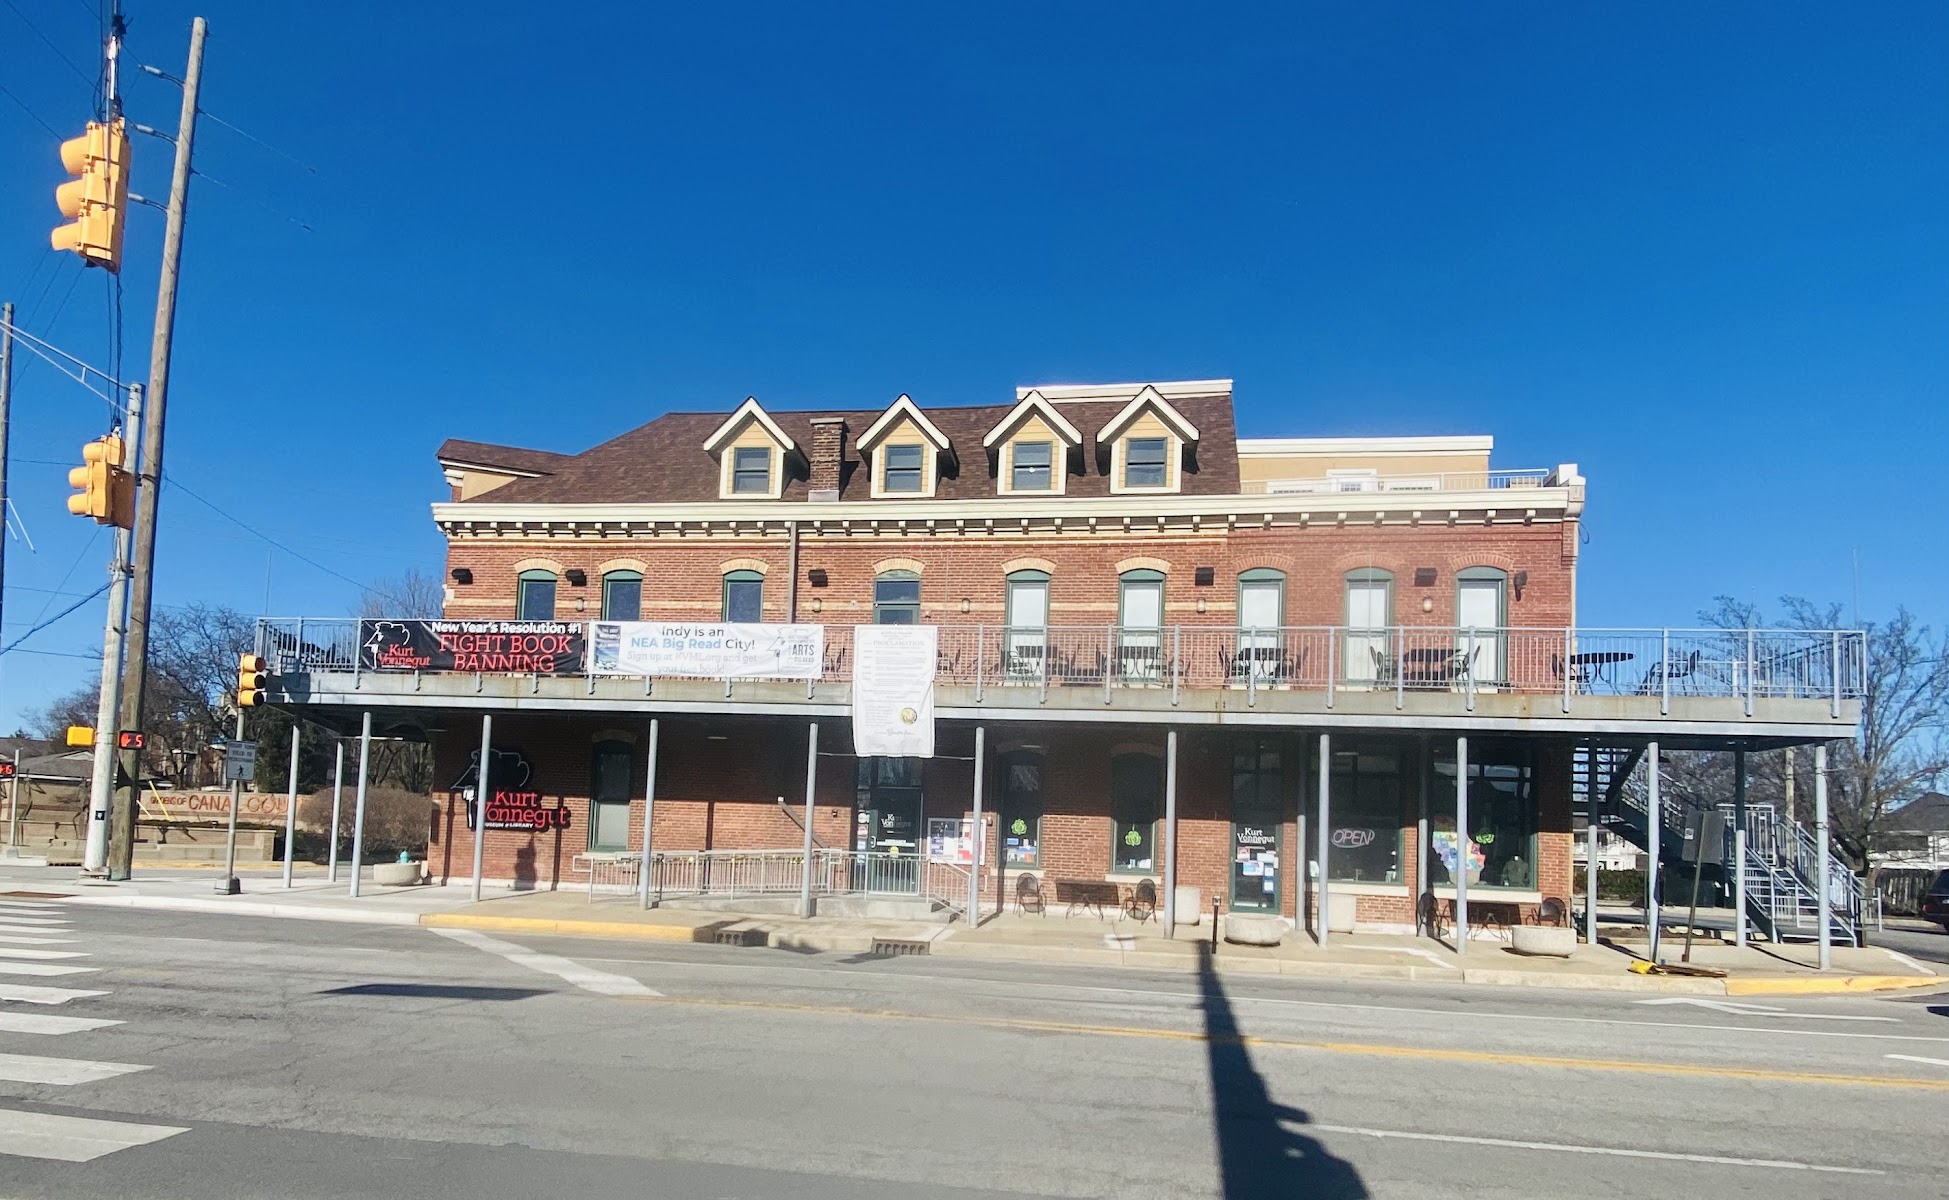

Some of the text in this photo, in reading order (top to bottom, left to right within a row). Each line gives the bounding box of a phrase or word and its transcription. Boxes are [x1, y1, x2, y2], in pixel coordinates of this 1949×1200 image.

[432, 622, 581, 634] New Year's Resolution #1
[694, 626, 704, 637] is
[708, 628, 724, 637] an
[388, 644, 414, 656] Kurt
[439, 634, 573, 653] FIGHT BOOK
[631, 637, 756, 651] NEA Big Read City!
[792, 644, 815, 656] ARTS
[378, 653, 431, 669] Vonnegut
[453, 654, 554, 672] BANNING
[627, 651, 648, 661] Sign
[650, 652, 662, 663] up
[664, 652, 673, 661] at
[723, 653, 741, 663] and
[743, 655, 758, 665] get
[135, 734, 143, 748] 5
[494, 790, 538, 807] Kurt
[1237, 833, 1275, 845] Vonnegut
[1244, 827, 1263, 837] Kurt
[1333, 829, 1372, 845] OPEN
